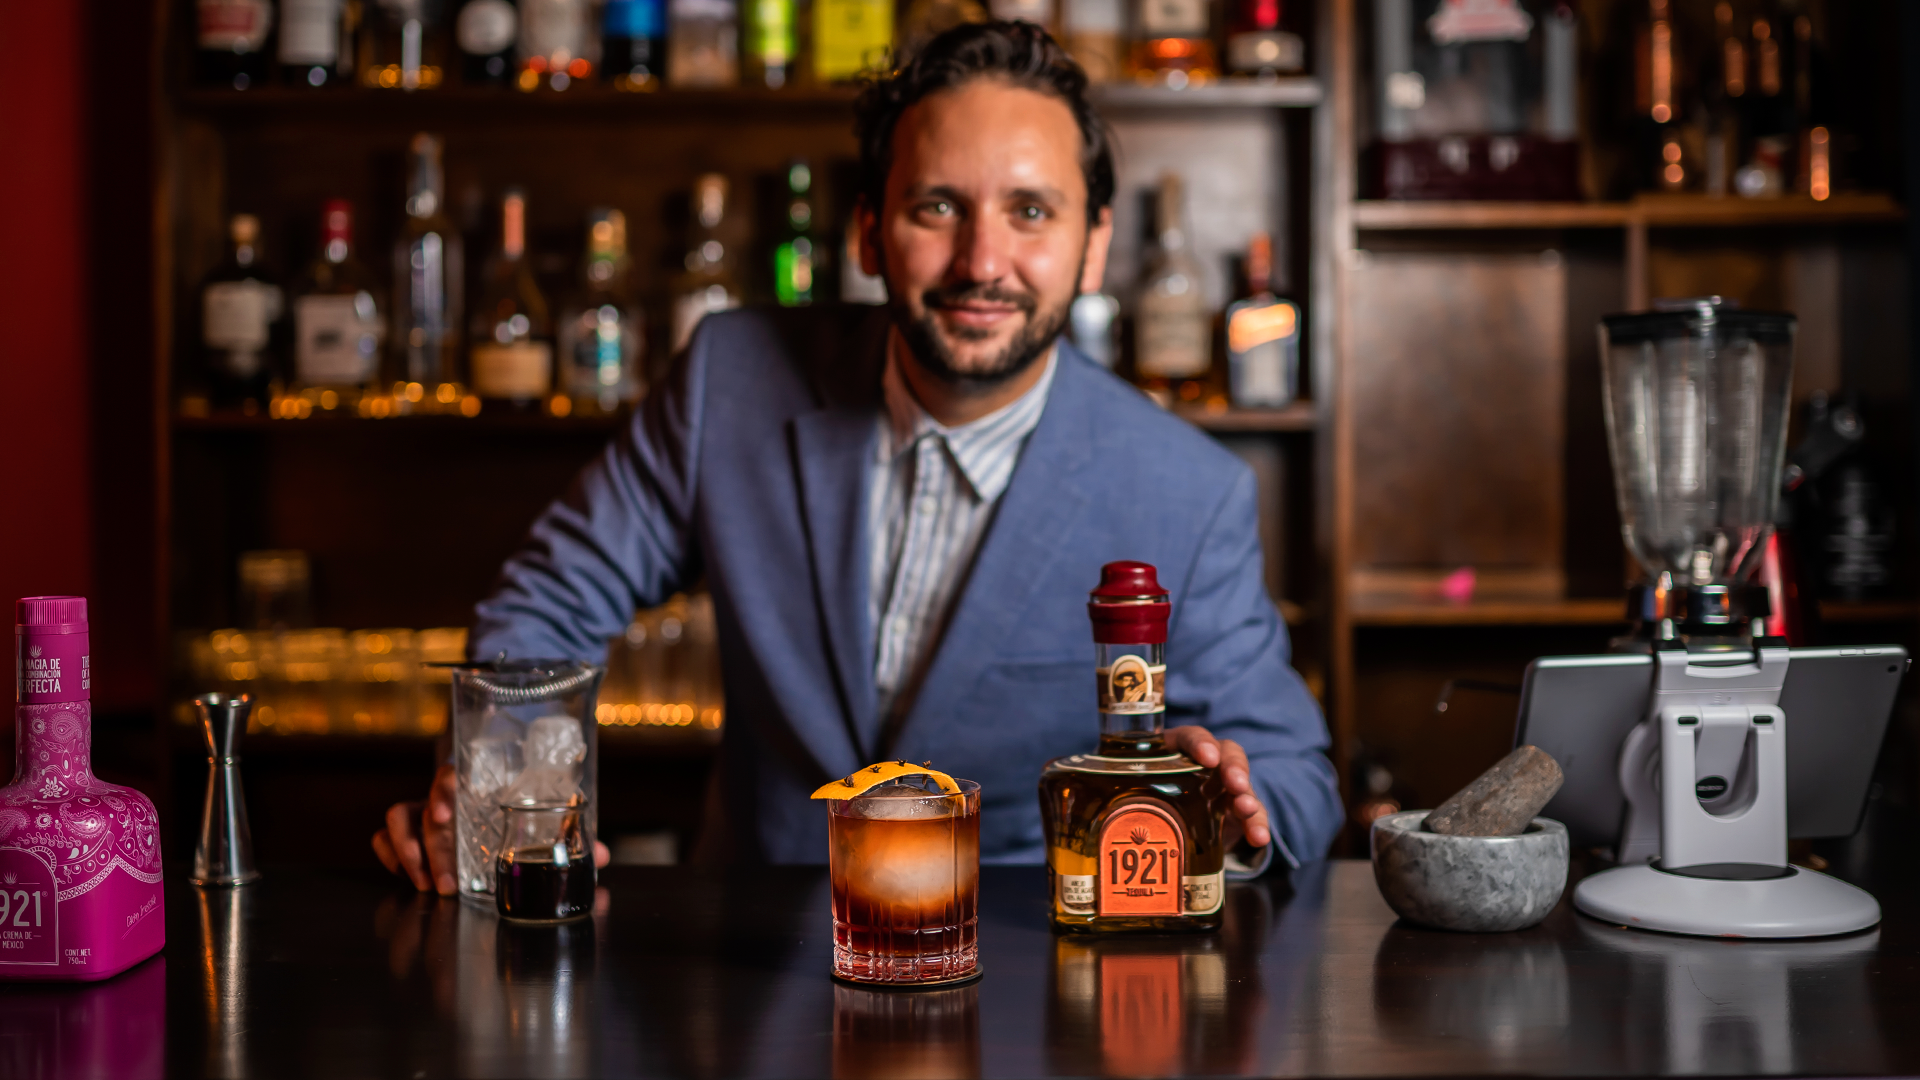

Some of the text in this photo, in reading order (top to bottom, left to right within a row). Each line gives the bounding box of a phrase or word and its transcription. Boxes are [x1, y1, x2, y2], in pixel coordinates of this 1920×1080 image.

[25, 658, 48, 670] MAGIA
[50, 658, 61, 670] DE
[1109, 849, 1168, 885] 1921
[1126, 887, 1154, 897] TEQUILA
[2, 931, 23, 940] CREMA
[24, 931, 33, 940] DE
